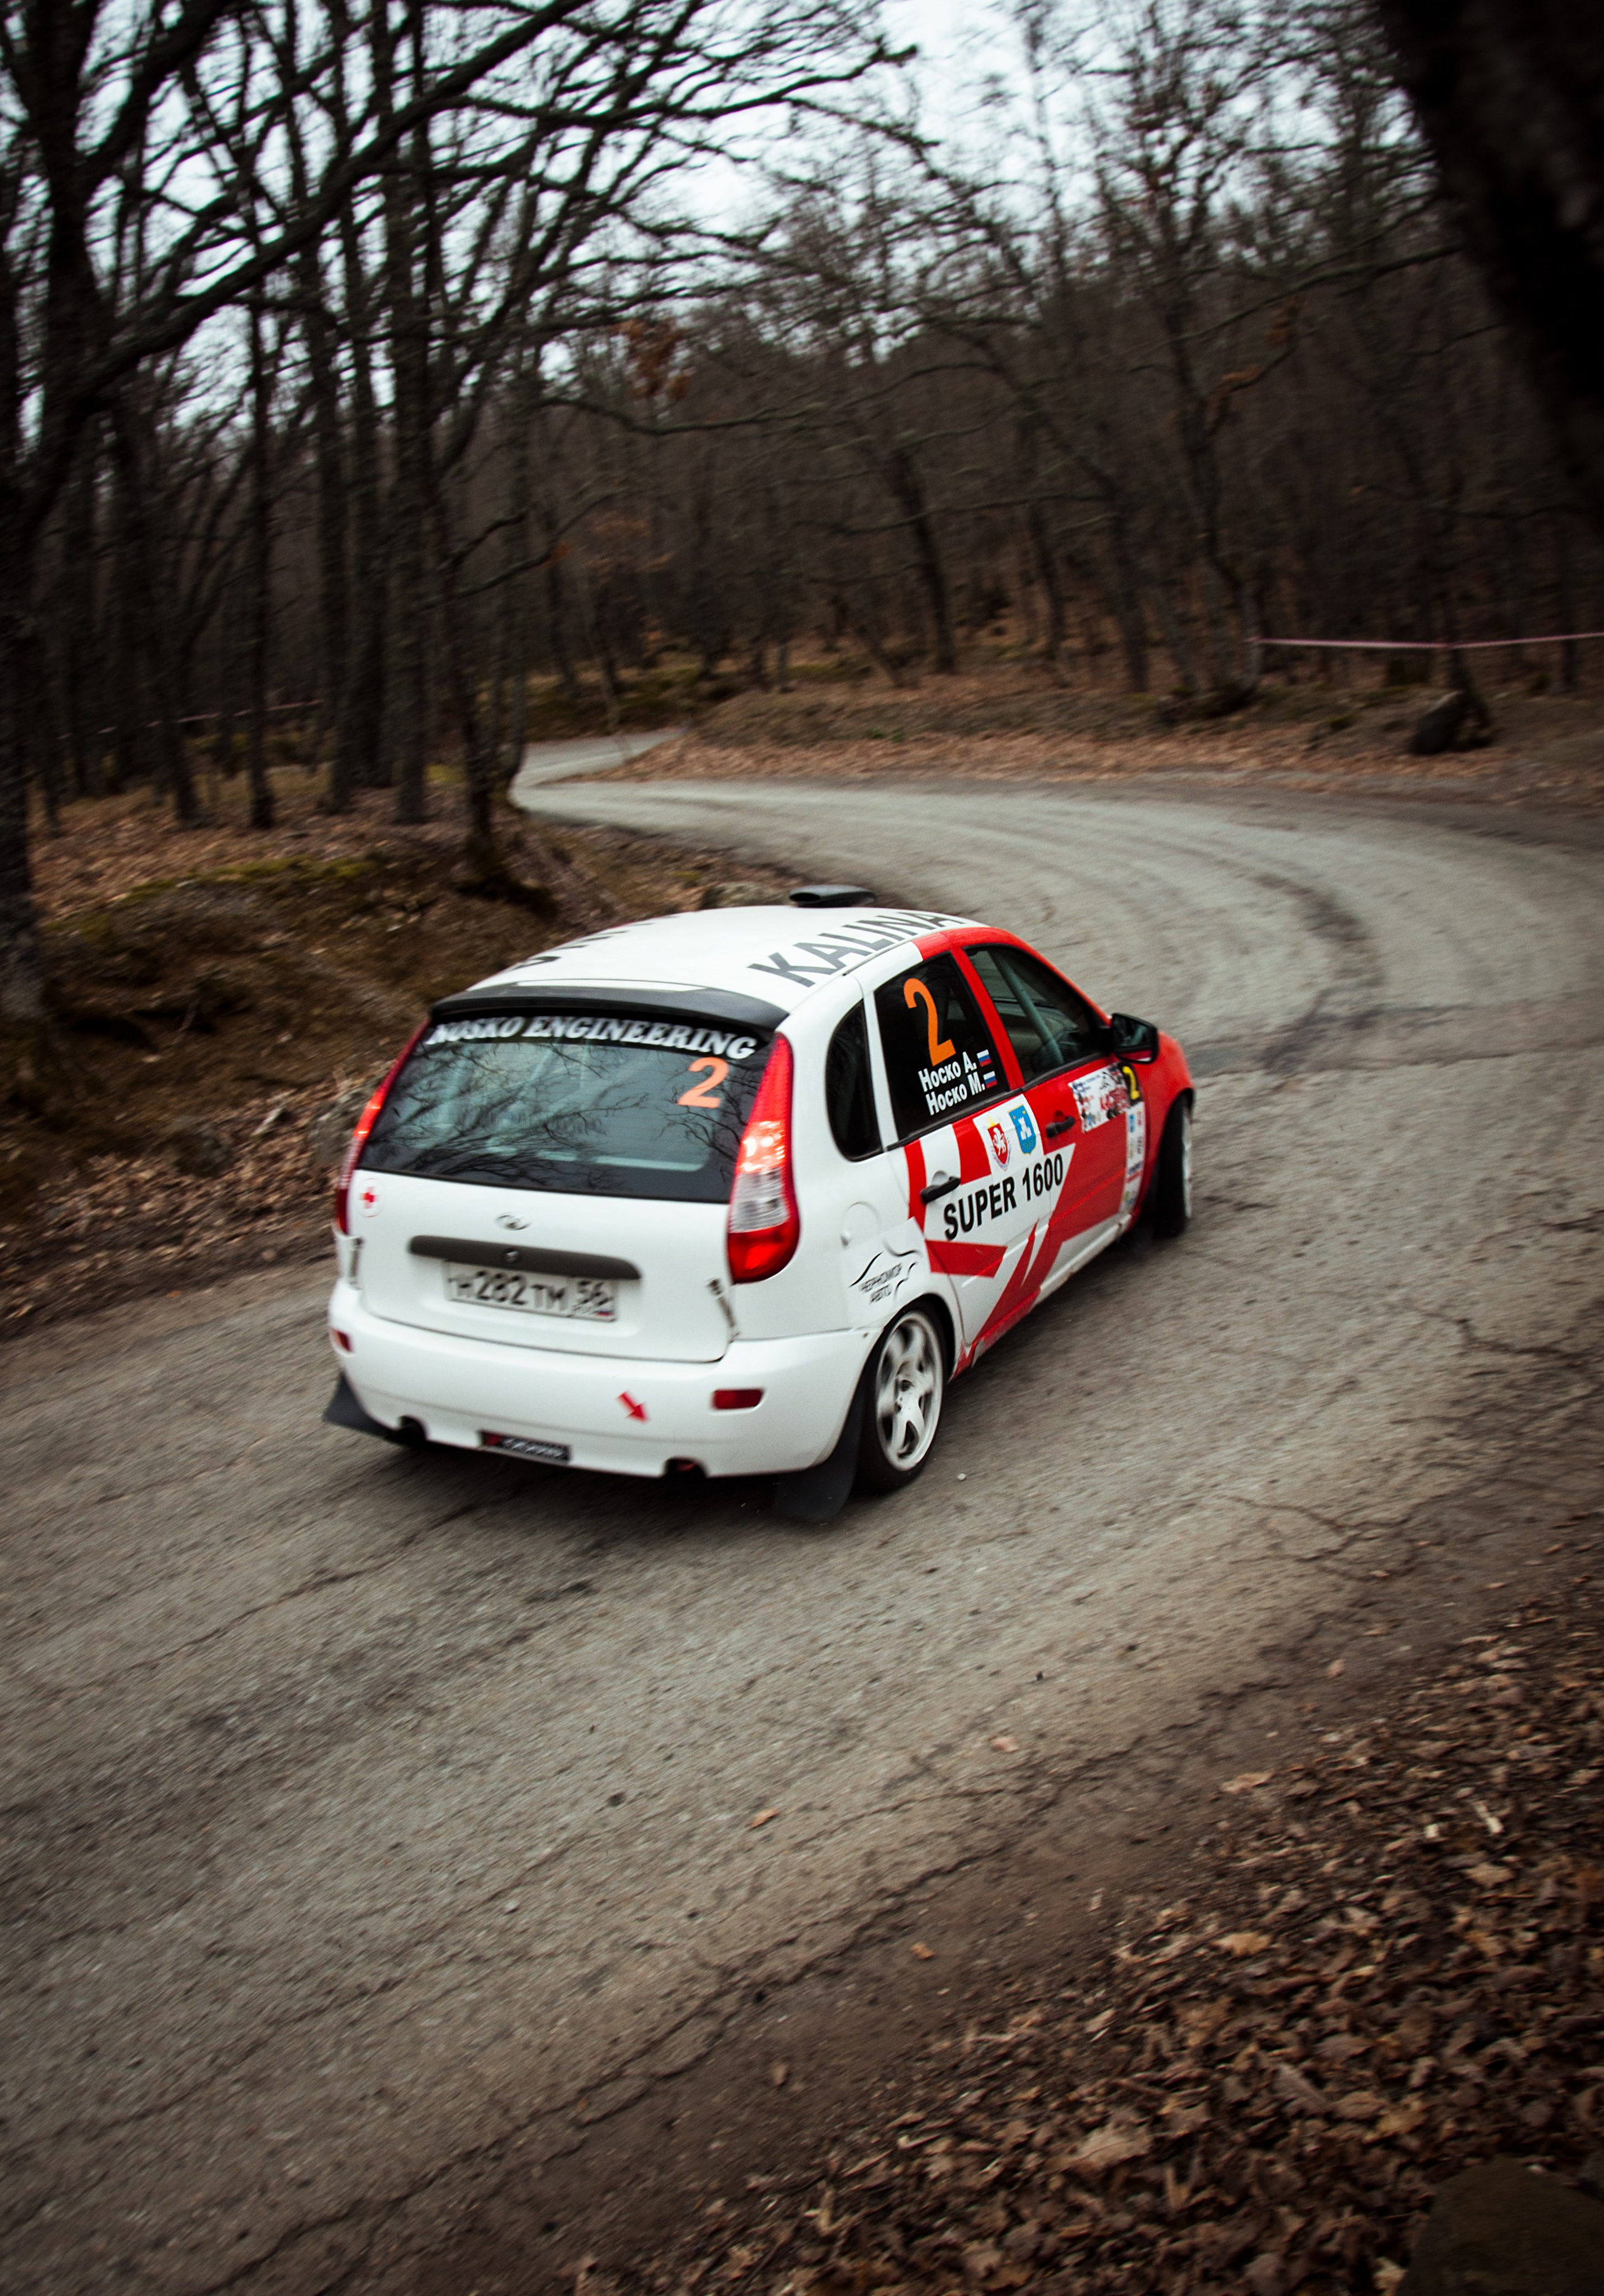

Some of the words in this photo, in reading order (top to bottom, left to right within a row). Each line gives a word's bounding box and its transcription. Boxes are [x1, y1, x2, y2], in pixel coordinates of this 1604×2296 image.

[746, 912, 966, 988] KALINA
[425, 1016, 524, 1045] NOSKO
[521, 1016, 758, 1059] ENGINEERING
[904, 978, 956, 1066] 2
[677, 1057, 729, 1108] 2
[918, 1062, 961, 1092] Носко
[925, 1083, 967, 1116] Носко
[1122, 1066, 1140, 1100] 2
[944, 1176, 1017, 1241] SUPER
[1022, 1153, 1063, 1201] 1600
